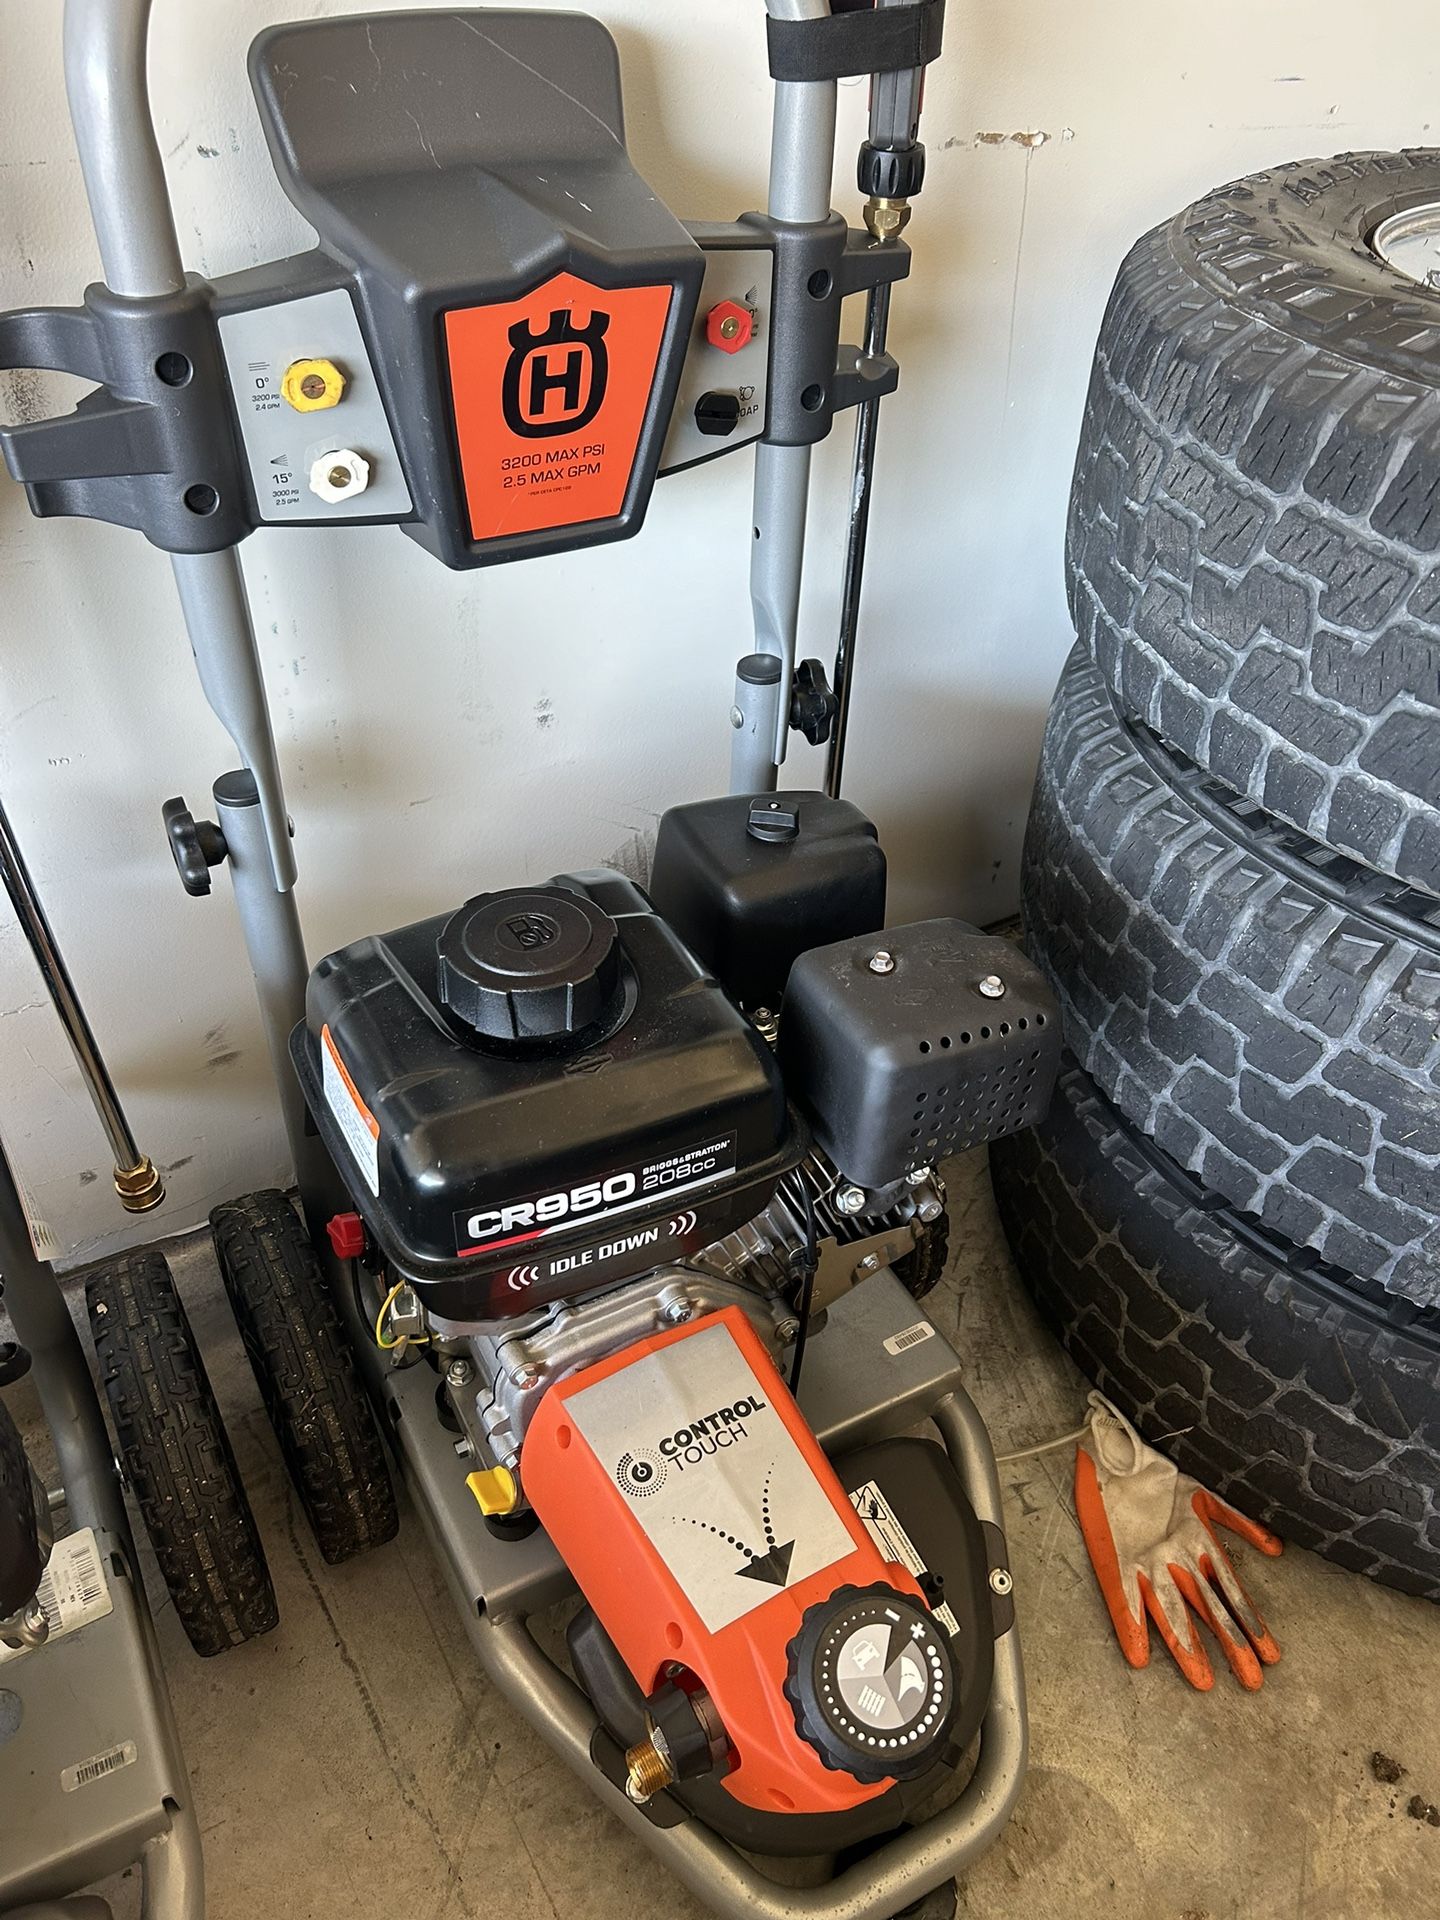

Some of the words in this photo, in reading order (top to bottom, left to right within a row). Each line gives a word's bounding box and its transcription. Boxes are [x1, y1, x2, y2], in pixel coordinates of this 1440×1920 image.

[255, 377, 270, 389] 0°
[251, 393, 270, 402] 3200
[739, 404, 759, 417] OAP
[501, 453, 542, 471] 3200
[545, 447, 579, 464] MAX
[582, 443, 605, 458] PSI
[272, 472, 293, 484] 15°
[503, 475, 527, 489] 2.5
[530, 467, 565, 485] MAX
[567, 462, 601, 478] GPM
[272, 489, 290, 498] 3000
[642, 1158, 716, 1190] 208cc
[466, 1172, 636, 1239] CR950
[550, 1250, 593, 1276] IDLE
[599, 1228, 659, 1260] DOWN
[658, 1395, 767, 1455] CONTROL
[667, 1422, 749, 1472] TOUCH
